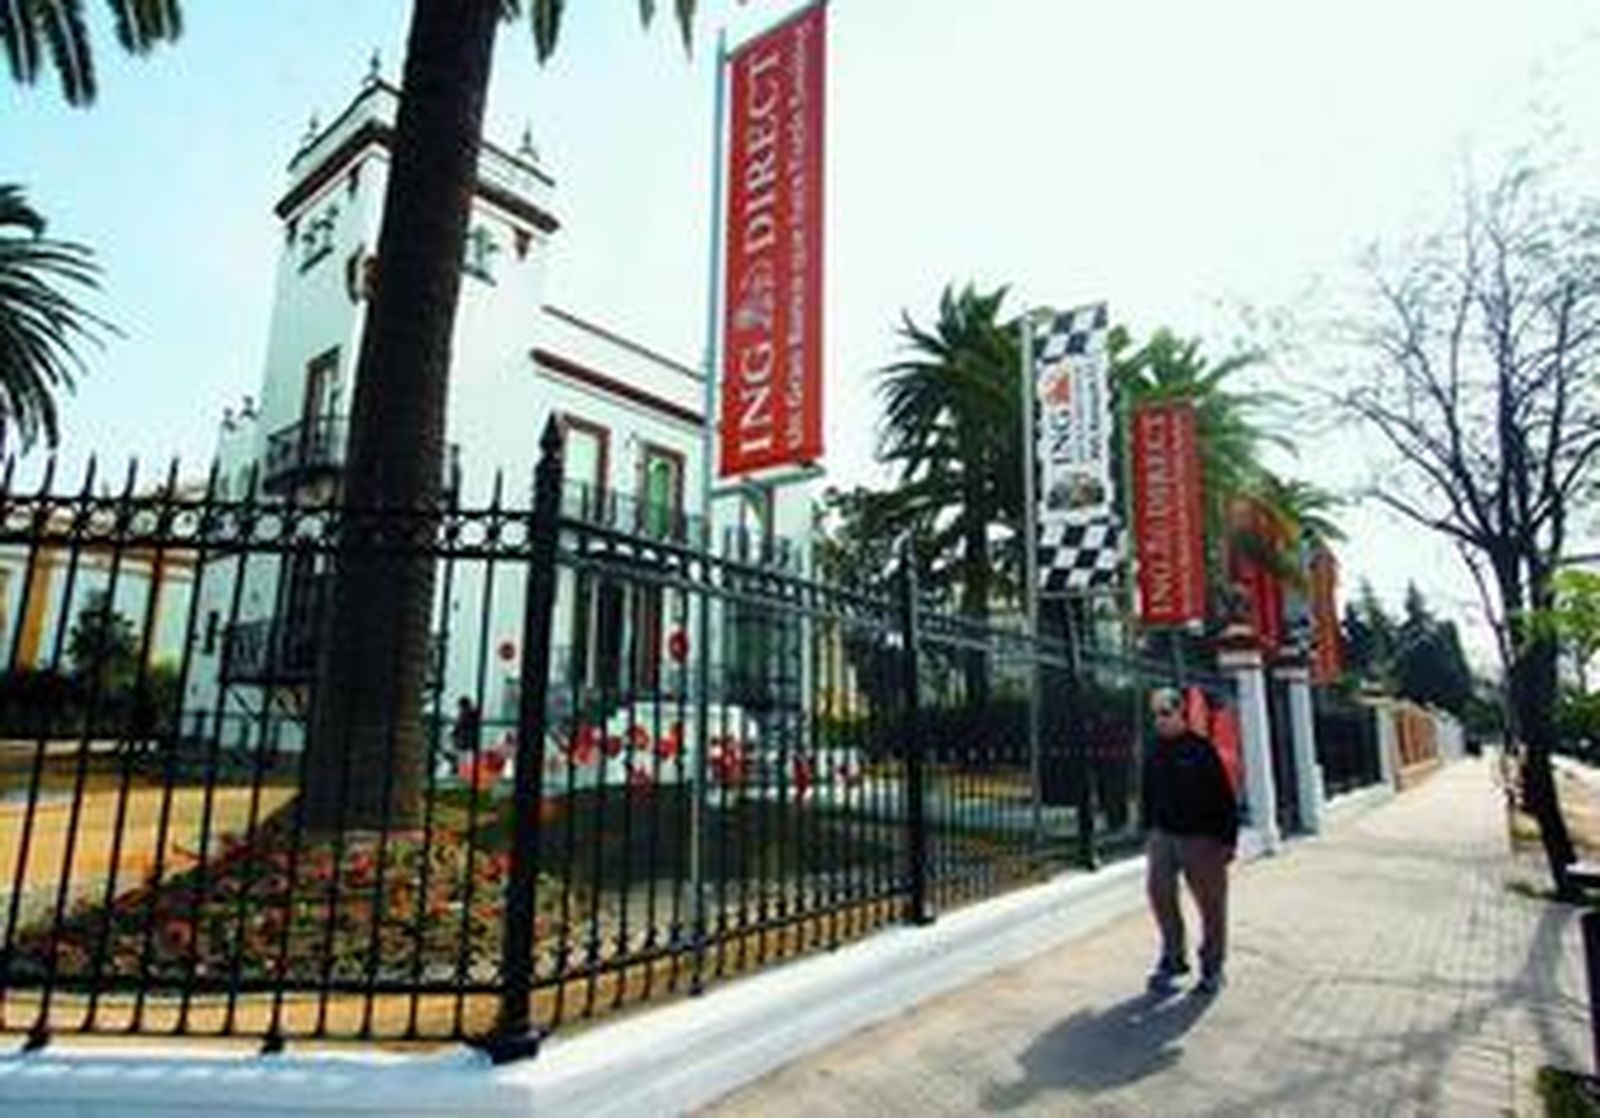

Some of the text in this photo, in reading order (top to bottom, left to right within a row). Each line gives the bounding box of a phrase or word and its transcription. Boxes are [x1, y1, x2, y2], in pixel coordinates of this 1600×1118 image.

[740, 53, 780, 454] ING DIRECT
[1050, 410, 1071, 465] ING
[1145, 414, 1169, 517] DIRECT
